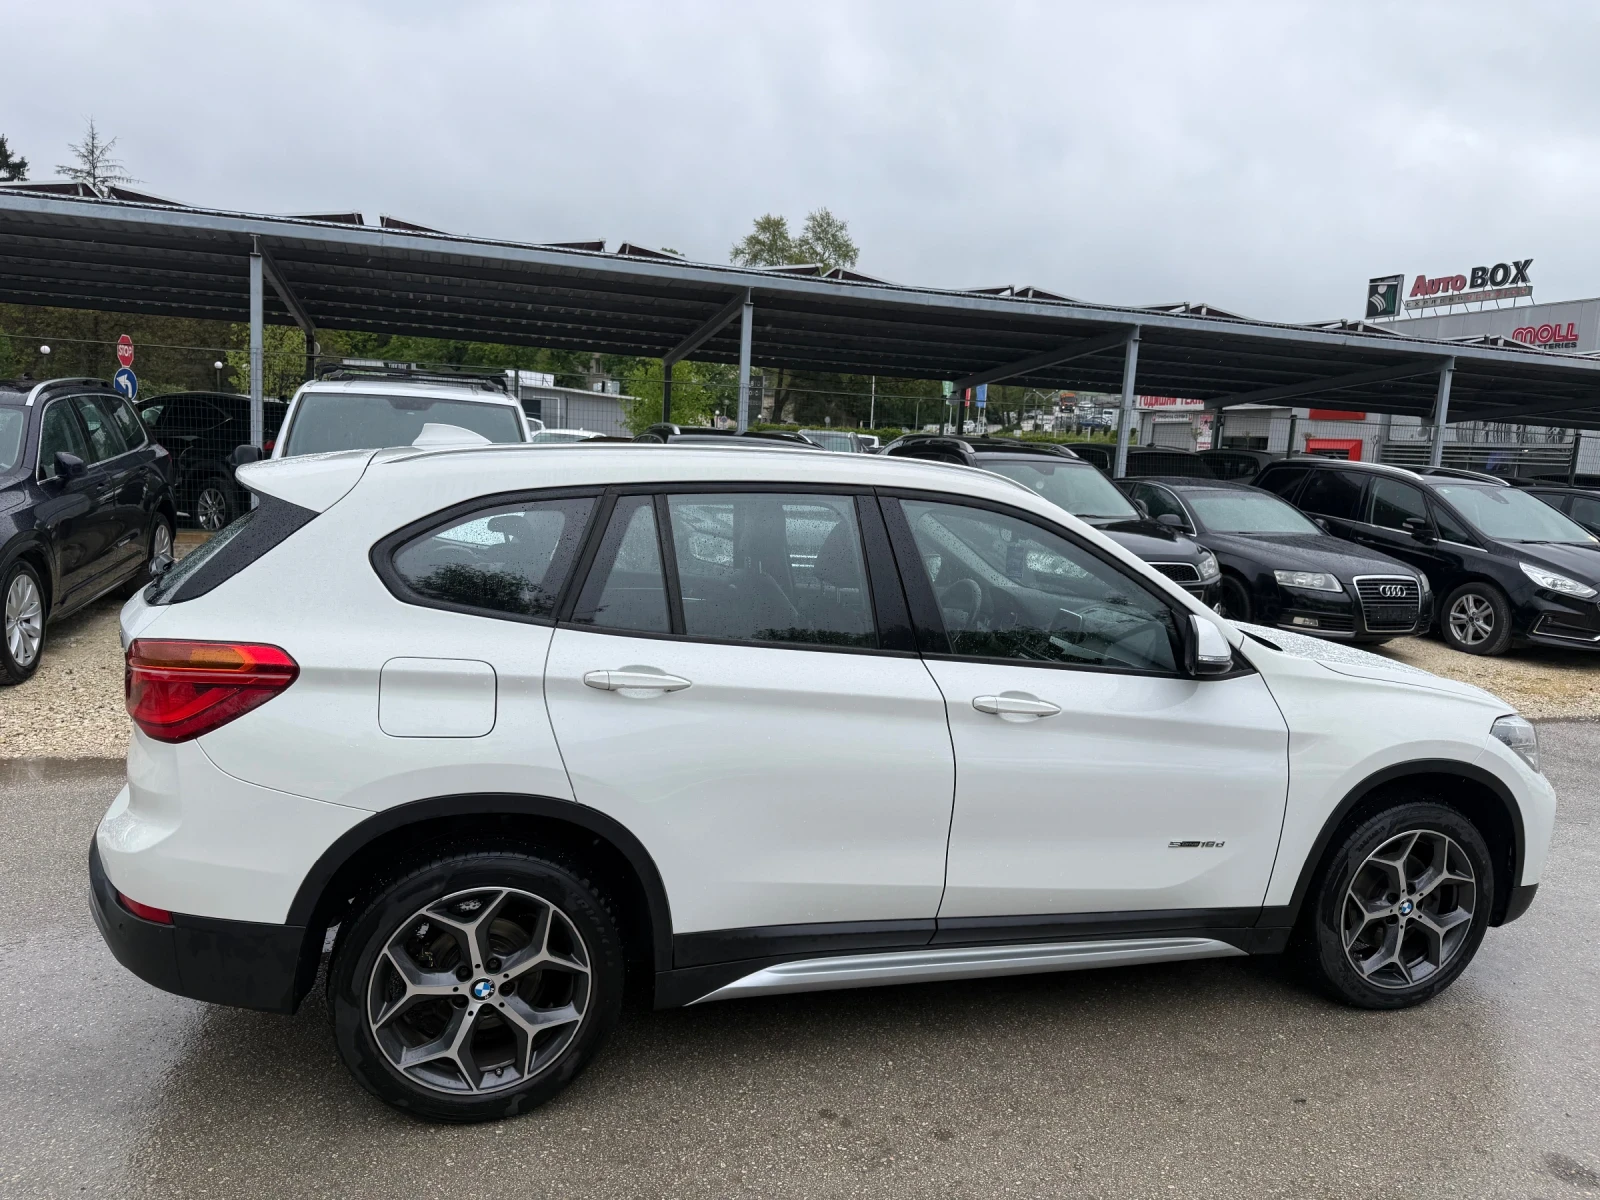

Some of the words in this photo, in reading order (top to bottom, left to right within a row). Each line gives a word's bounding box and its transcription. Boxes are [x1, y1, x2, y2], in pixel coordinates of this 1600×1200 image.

[1469, 258, 1534, 290] BOX
[1512, 322, 1578, 344] MOLL
[118, 345, 133, 357] STOP
